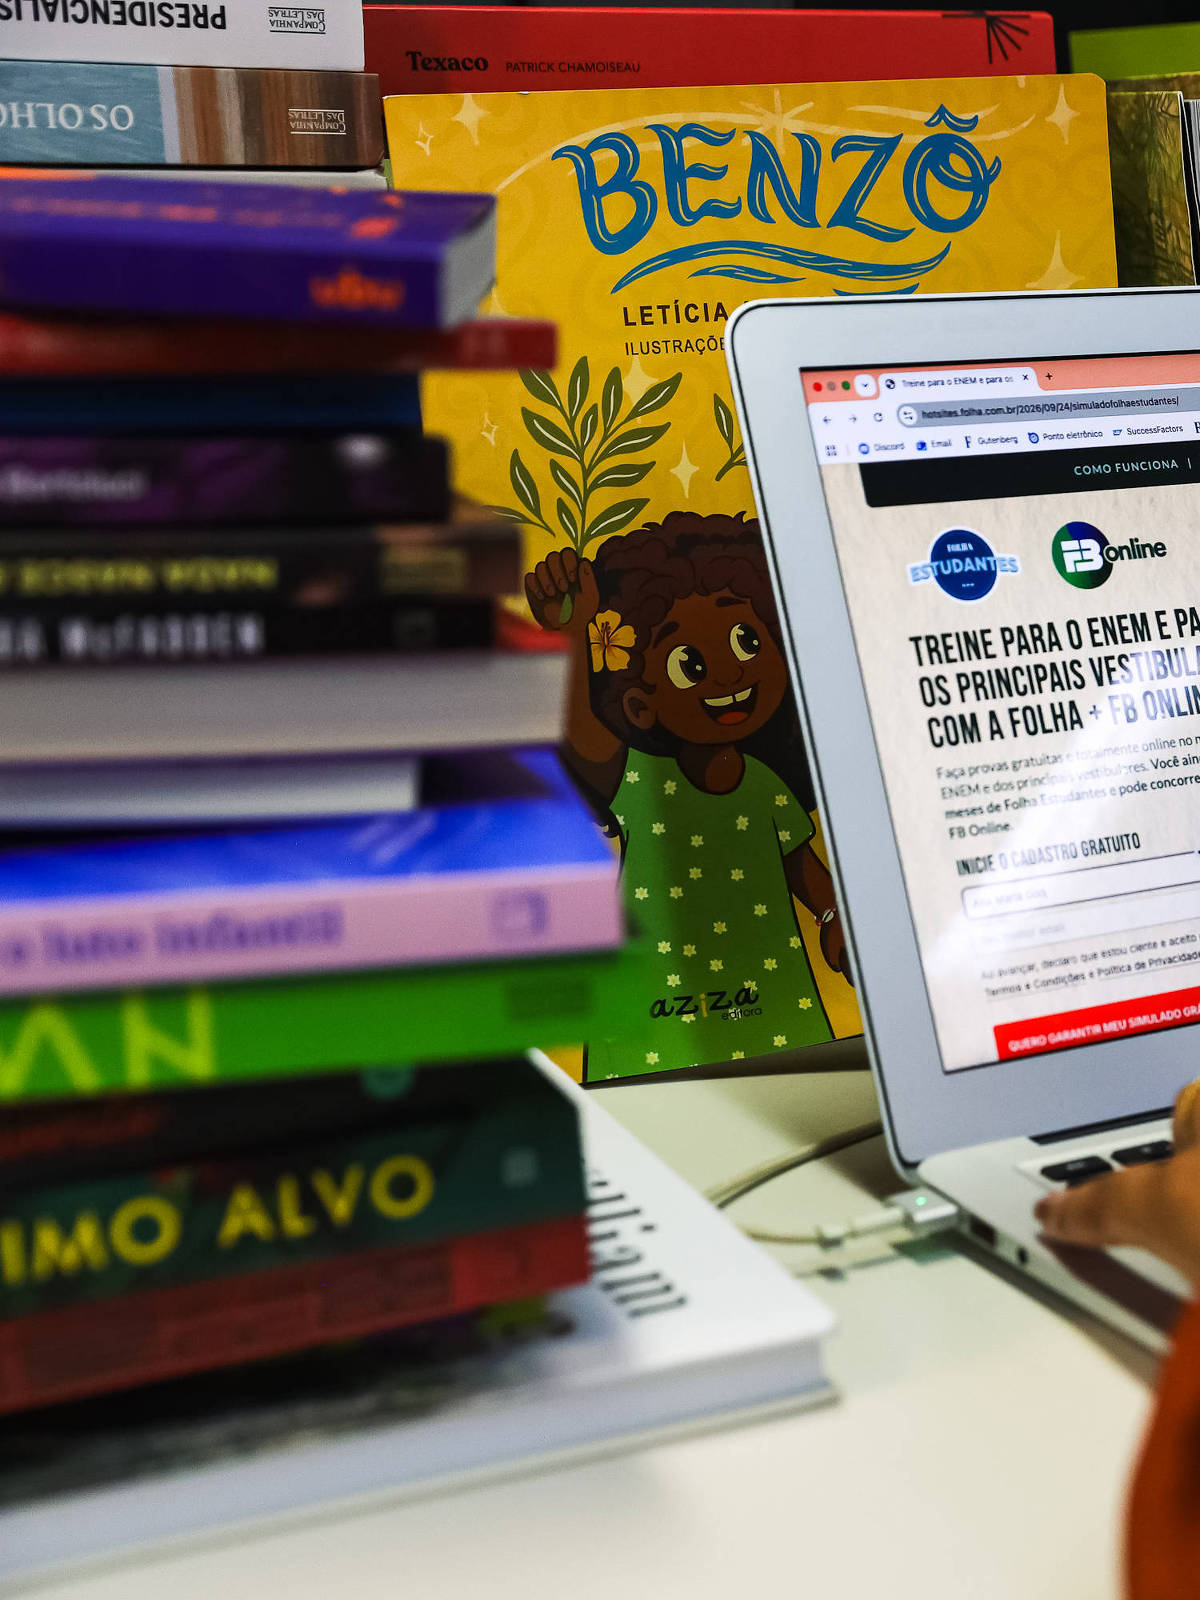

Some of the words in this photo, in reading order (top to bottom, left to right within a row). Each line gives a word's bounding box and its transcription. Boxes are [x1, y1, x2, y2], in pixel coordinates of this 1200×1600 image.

[268, 9, 305, 22] LETRAS
[269, 20, 326, 32] COMPANHIA
[306, 12, 325, 22] DAS
[406, 51, 489, 73] Texaco
[505, 61, 556, 74] PATRICK
[558, 61, 641, 74] CHAMOISEAU
[0, 103, 83, 131] OLH
[92, 105, 134, 131] OS
[290, 121, 346, 132] COMPANHIA
[551, 104, 1002, 255] BENZÔ
[623, 300, 729, 327] LETÍCIA
[953, 377, 977, 385] ENEM
[931, 438, 953, 449] Email
[977, 434, 1018, 446] Gutenberg
[1042, 431, 1064, 441] Ponto
[1066, 429, 1103, 439] eletrônico
[1127, 424, 1184, 436] SuccessFactors
[1073, 464, 1112, 476] COMO
[1114, 460, 1179, 474] FUNCIONA
[1105, 537, 1167, 563] online
[911, 556, 1019, 582] ESTUDANTES
[909, 628, 997, 667] TREINE
[1000, 622, 1063, 658] PARA
[1066, 619, 1083, 650] O
[1087, 612, 1152, 648] ENEM
[1155, 610, 1171, 640] E
[919, 674, 951, 708] OS
[956, 658, 1086, 704] PRINCIPAIS
[927, 710, 982, 748] COM
[988, 710, 1005, 741] A
[1008, 700, 1084, 738] FOLHA
[1109, 694, 1138, 725] FB
[936, 766, 966, 780] Faça
[968, 761, 1009, 777] provas
[1012, 753, 1065, 772] gratuitas
[1142, 738, 1177, 752] online
[1179, 736, 1193, 746] no
[941, 783, 981, 800] ENEM
[993, 781, 1015, 793] dos
[1150, 756, 1179, 770] Você
[945, 806, 984, 819] meses
[986, 801, 1001, 814] de
[1003, 797, 1038, 811] Folha
[1119, 780, 1148, 797] pode
[948, 826, 966, 839] FB
[956, 854, 995, 877] INICIE
[1011, 842, 1078, 868] CADASTRO
[1080, 832, 1141, 857] GRATUITO
[1081, 951, 1099, 963] que
[1101, 946, 1128, 959] estou
[1130, 940, 1158, 953] ciente
[1169, 934, 1197, 947] aceito
[1033, 972, 1086, 988] Condições
[1097, 963, 1132, 978] Política
[1134, 959, 1147, 970] de
[650, 986, 760, 1019] aziza
[721, 1006, 763, 1021] editora
[1008, 1034, 1047, 1053] QUERO
[1048, 1023, 1102, 1046] GARANTIR
[1103, 1019, 1127, 1034] MEU
[1128, 1009, 1181, 1029] SIMULADO
[217, 1154, 435, 1250] ALVO
